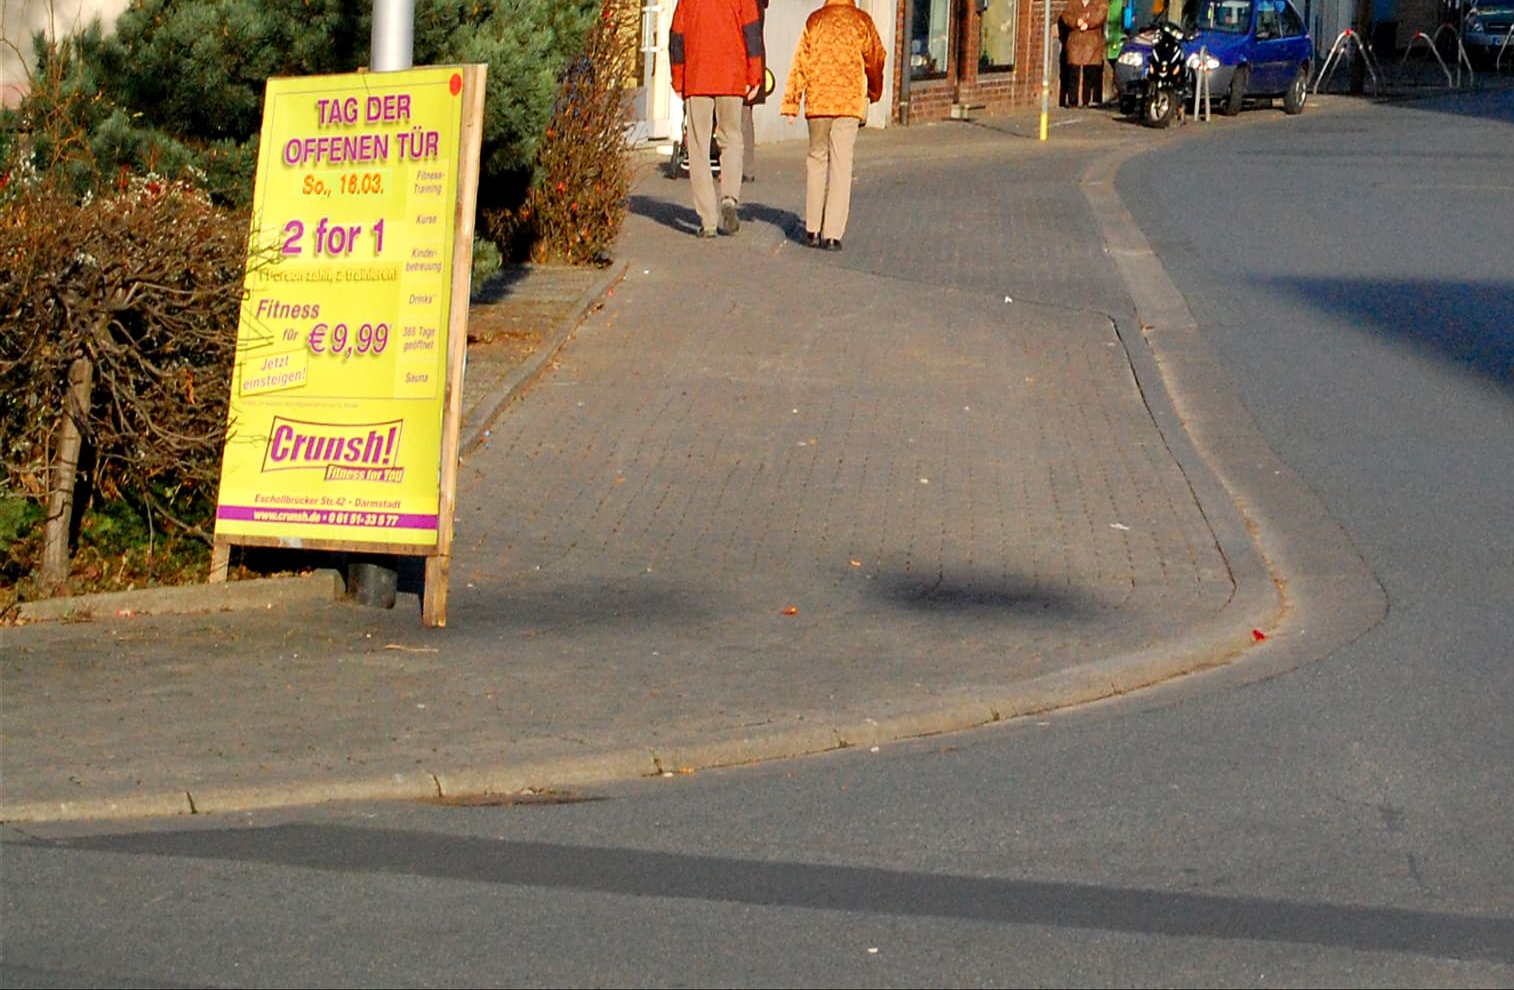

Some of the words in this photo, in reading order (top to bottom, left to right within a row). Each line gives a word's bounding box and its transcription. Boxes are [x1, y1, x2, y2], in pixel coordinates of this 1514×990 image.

[316, 97, 359, 125] TAG
[366, 94, 411, 121] DER
[285, 134, 389, 164] OFFENEN
[397, 126, 439, 158] TÜR
[282, 219, 304, 255] 2
[316, 217, 362, 254] for
[373, 218, 385, 253] 1
[256, 299, 320, 319] Fitness
[282, 328, 299, 341] für
[261, 355, 289, 371] Jetzt
[243, 367, 306, 390] einsteigen!
[269, 425, 397, 465] Crunsh!
